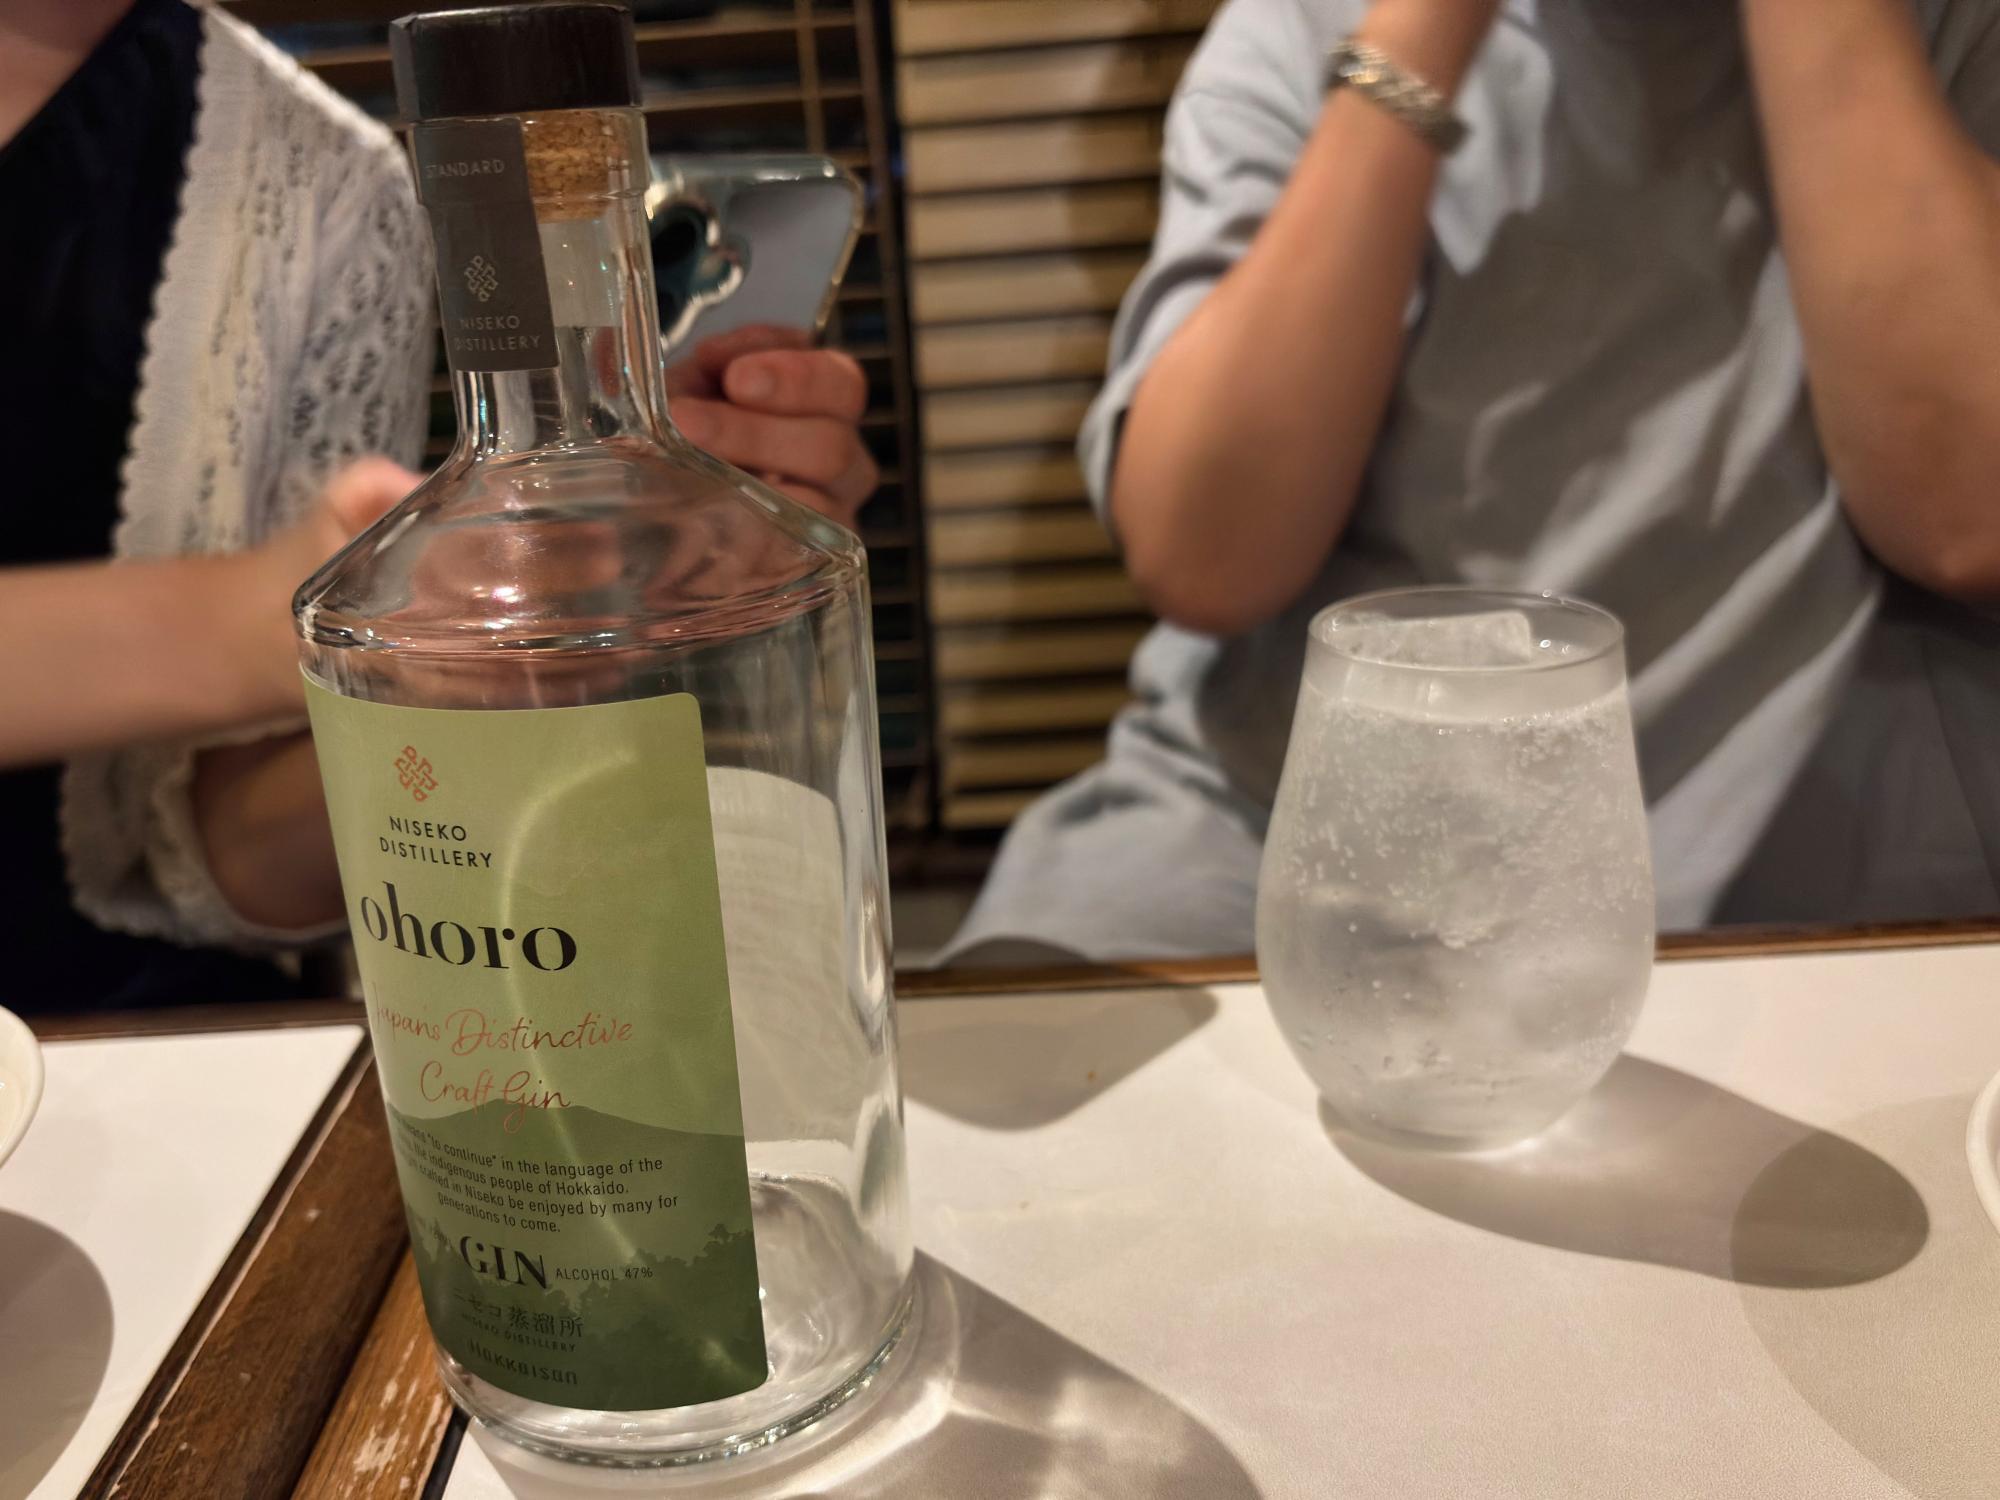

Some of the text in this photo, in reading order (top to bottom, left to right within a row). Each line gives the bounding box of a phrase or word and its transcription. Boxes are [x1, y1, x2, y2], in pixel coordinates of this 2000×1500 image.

[426, 159, 505, 178] STANDARD
[459, 315, 520, 331] NISEKO
[453, 334, 541, 352] DISTILLERY
[389, 815, 467, 841] NISEKO
[380, 836, 493, 868] DISTILLERY
[360, 881, 577, 971] ohoro
[445, 1008, 634, 1056] Distinctive
[420, 1060, 571, 1133] Craft Gin
[430, 1154, 487, 1185] indigenous
[490, 1175, 534, 1193] people
[538, 1180, 551, 1194] of
[557, 1181, 629, 1196] Hokkaido.
[443, 1143, 497, 1167] continue"
[502, 1157, 513, 1171] in
[518, 1160, 540, 1175] the
[545, 1161, 614, 1180] language
[620, 1159, 634, 1174] of
[639, 1158, 663, 1172] the
[438, 1191, 561, 1233] generations to come.
[453, 1182, 462, 1193] in
[465, 1185, 504, 1207] Niseko
[508, 1195, 524, 1210] be
[529, 1200, 584, 1216] enjoyed
[590, 1201, 606, 1217] by
[613, 1199, 653, 1214] many
[658, 1195, 679, 1209] for
[460, 1236, 654, 1290] GIN ALCOHOL 47%
